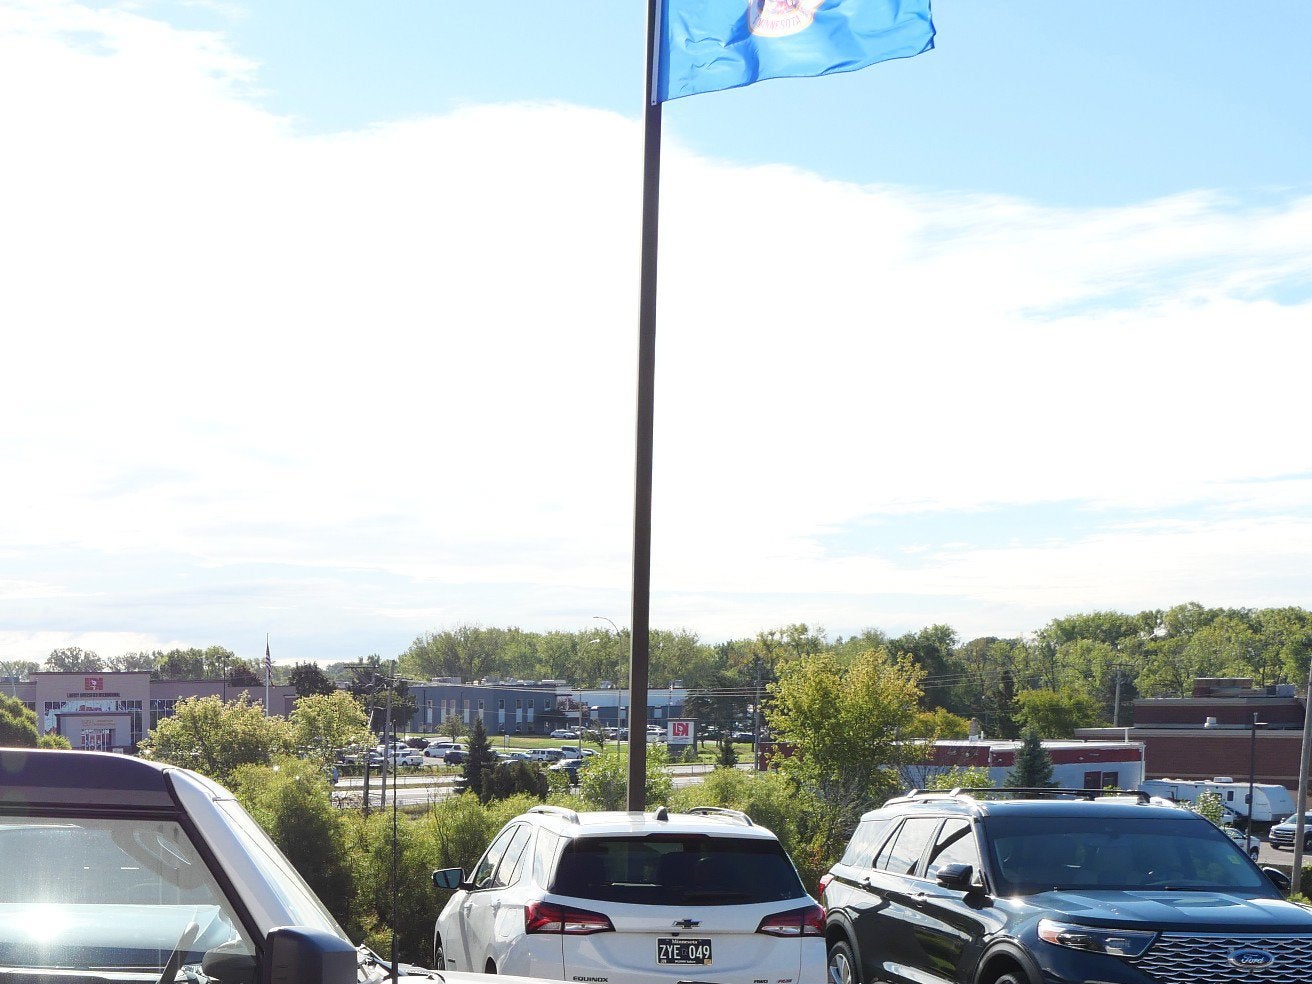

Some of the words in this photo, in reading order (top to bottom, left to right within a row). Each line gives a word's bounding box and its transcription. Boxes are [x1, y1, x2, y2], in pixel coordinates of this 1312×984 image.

[659, 944, 681, 959] ZYE
[688, 945, 710, 959] 049
[1241, 953, 1265, 964] Ford
[572, 975, 609, 983] EQUINOX
